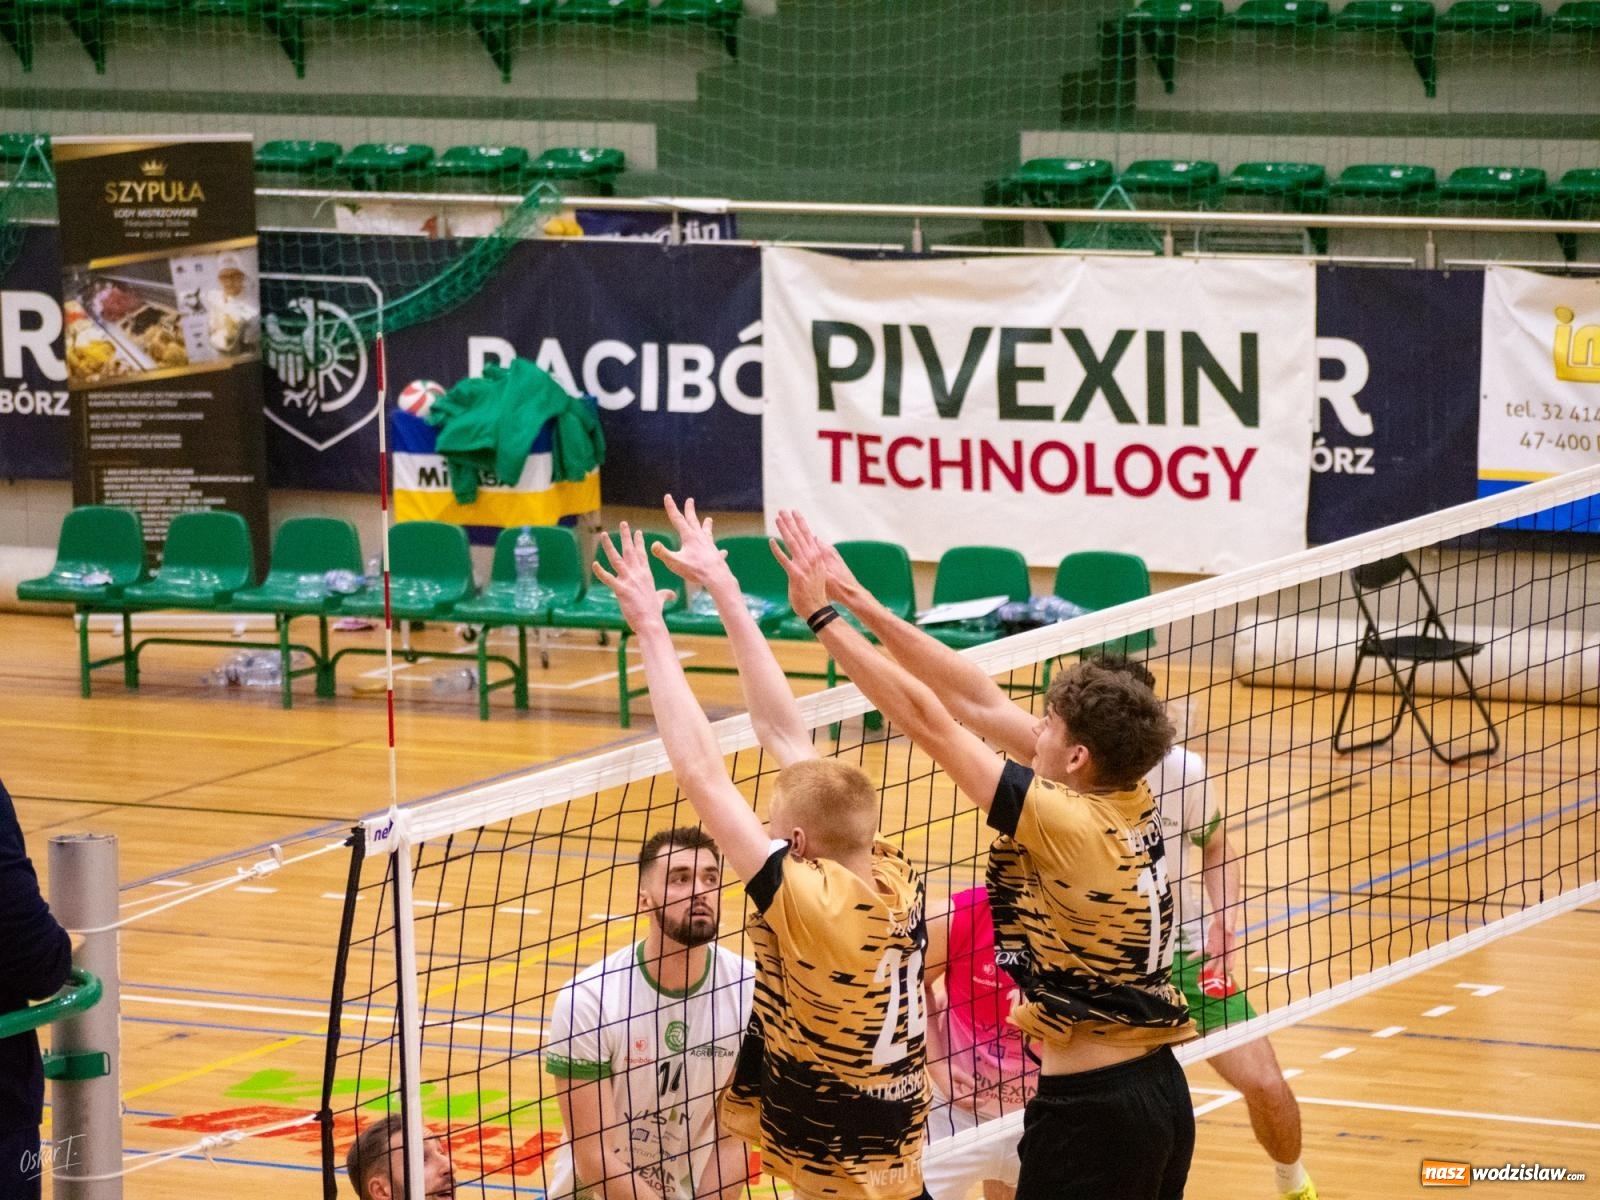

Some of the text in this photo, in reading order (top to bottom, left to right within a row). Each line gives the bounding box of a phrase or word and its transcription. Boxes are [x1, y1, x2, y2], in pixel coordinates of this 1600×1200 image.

[104, 180, 206, 203] SZYPUŁA
[0, 290, 69, 381] R
[811, 319, 1261, 429] PIVEXIN
[1506, 400, 1536, 418] tel.
[1541, 402, 1565, 421] 32
[1519, 431, 1592, 452] 47-400
[817, 430, 1259, 502] TECHNOLOGY
